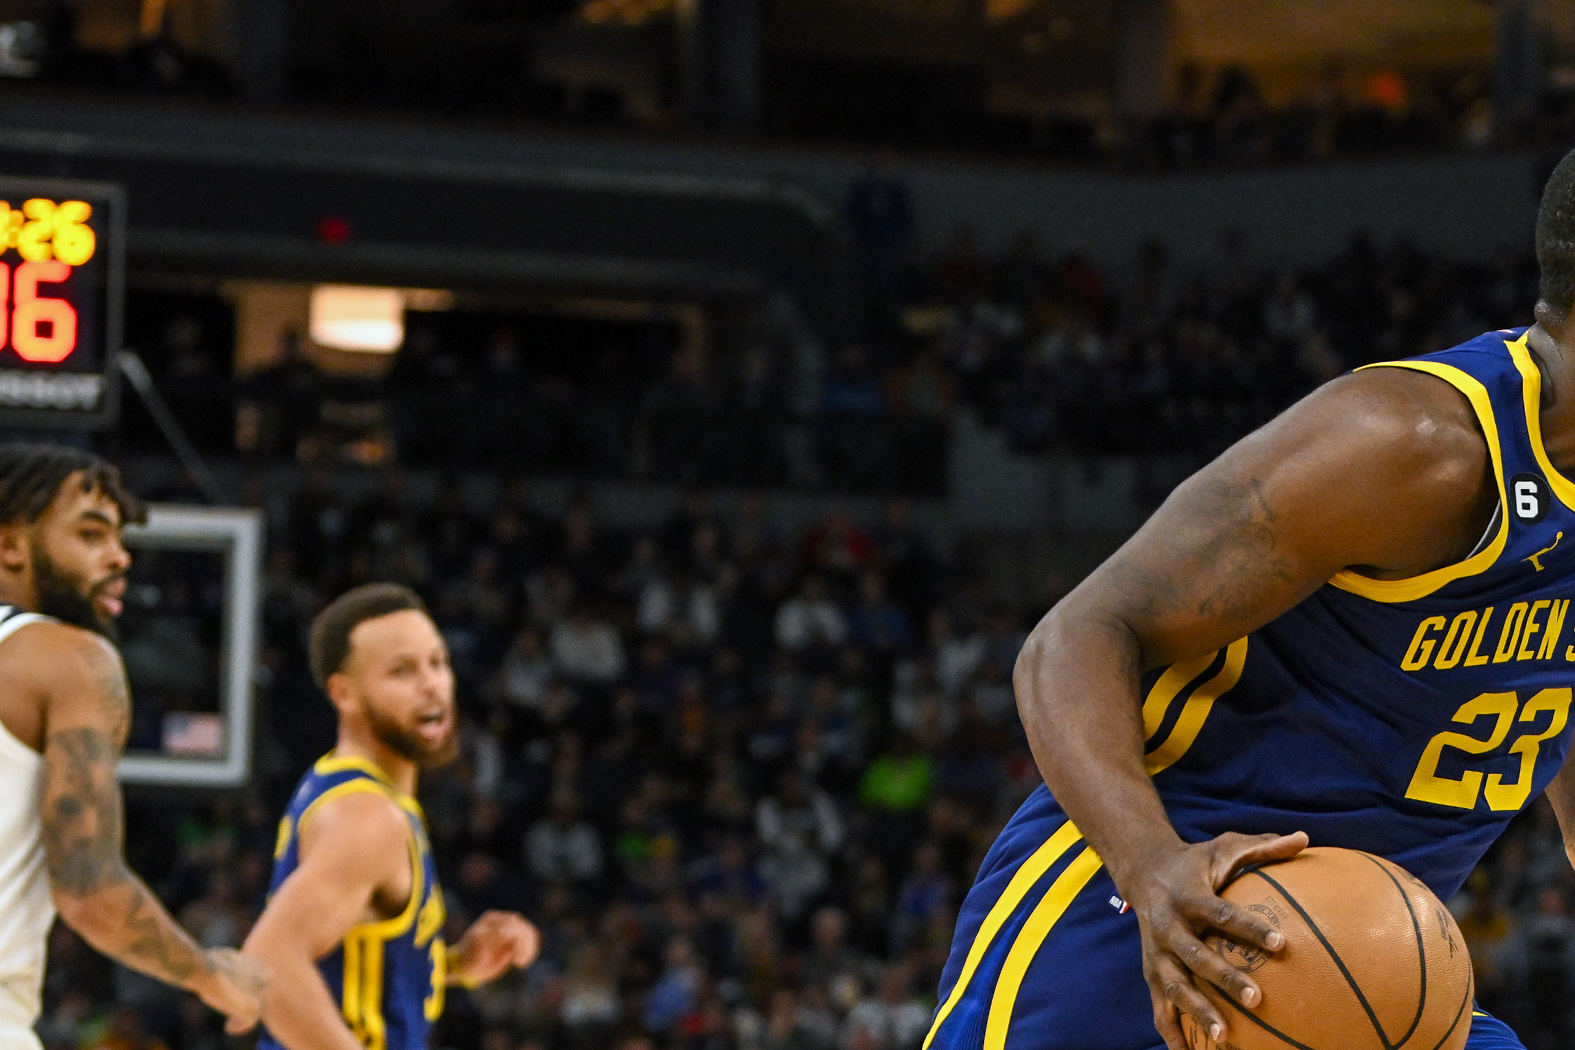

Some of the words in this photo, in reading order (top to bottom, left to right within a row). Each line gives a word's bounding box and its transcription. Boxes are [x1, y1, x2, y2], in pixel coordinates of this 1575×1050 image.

[0, 198, 96, 266] :26
[0, 258, 76, 362] 6
[1514, 480, 1539, 519] 6
[1400, 598, 1571, 673] GOLDEN
[1404, 687, 1573, 812] 23
[1109, 896, 1122, 909] NBA
